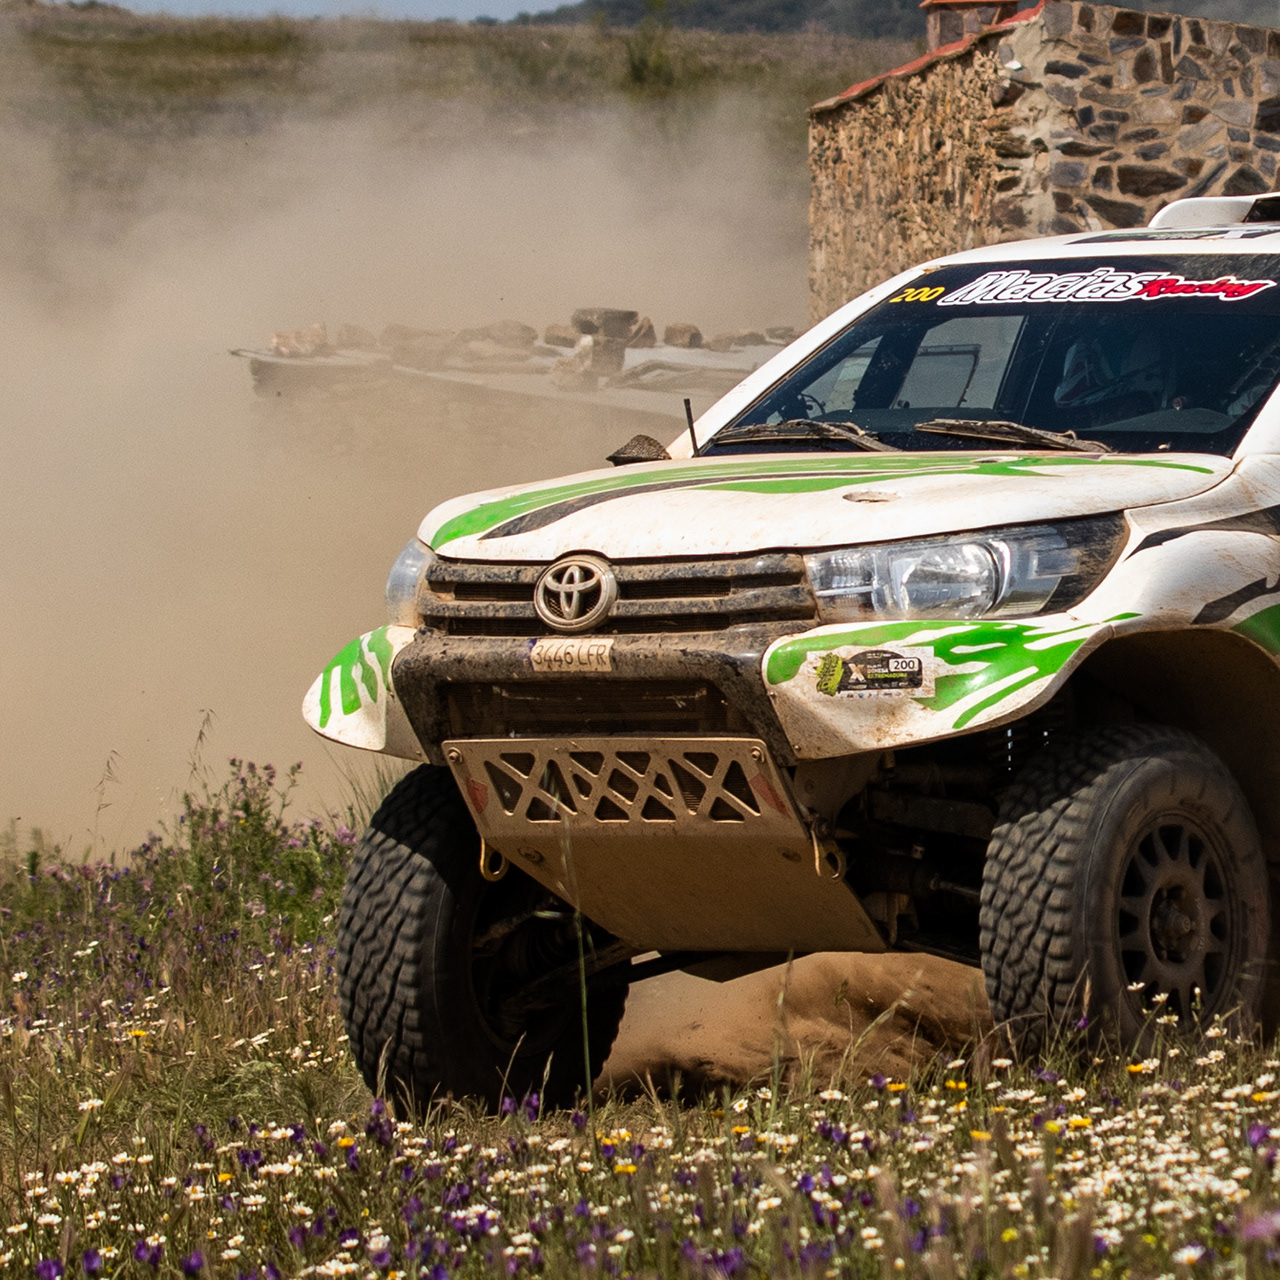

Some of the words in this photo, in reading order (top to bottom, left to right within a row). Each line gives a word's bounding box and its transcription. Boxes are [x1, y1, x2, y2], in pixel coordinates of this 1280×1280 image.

[888, 286, 946, 303] 200
[1135, 275, 1277, 301] Racing
[532, 644, 575, 668] 3446
[577, 644, 607, 665] LFR
[893, 660, 915, 670] 200
